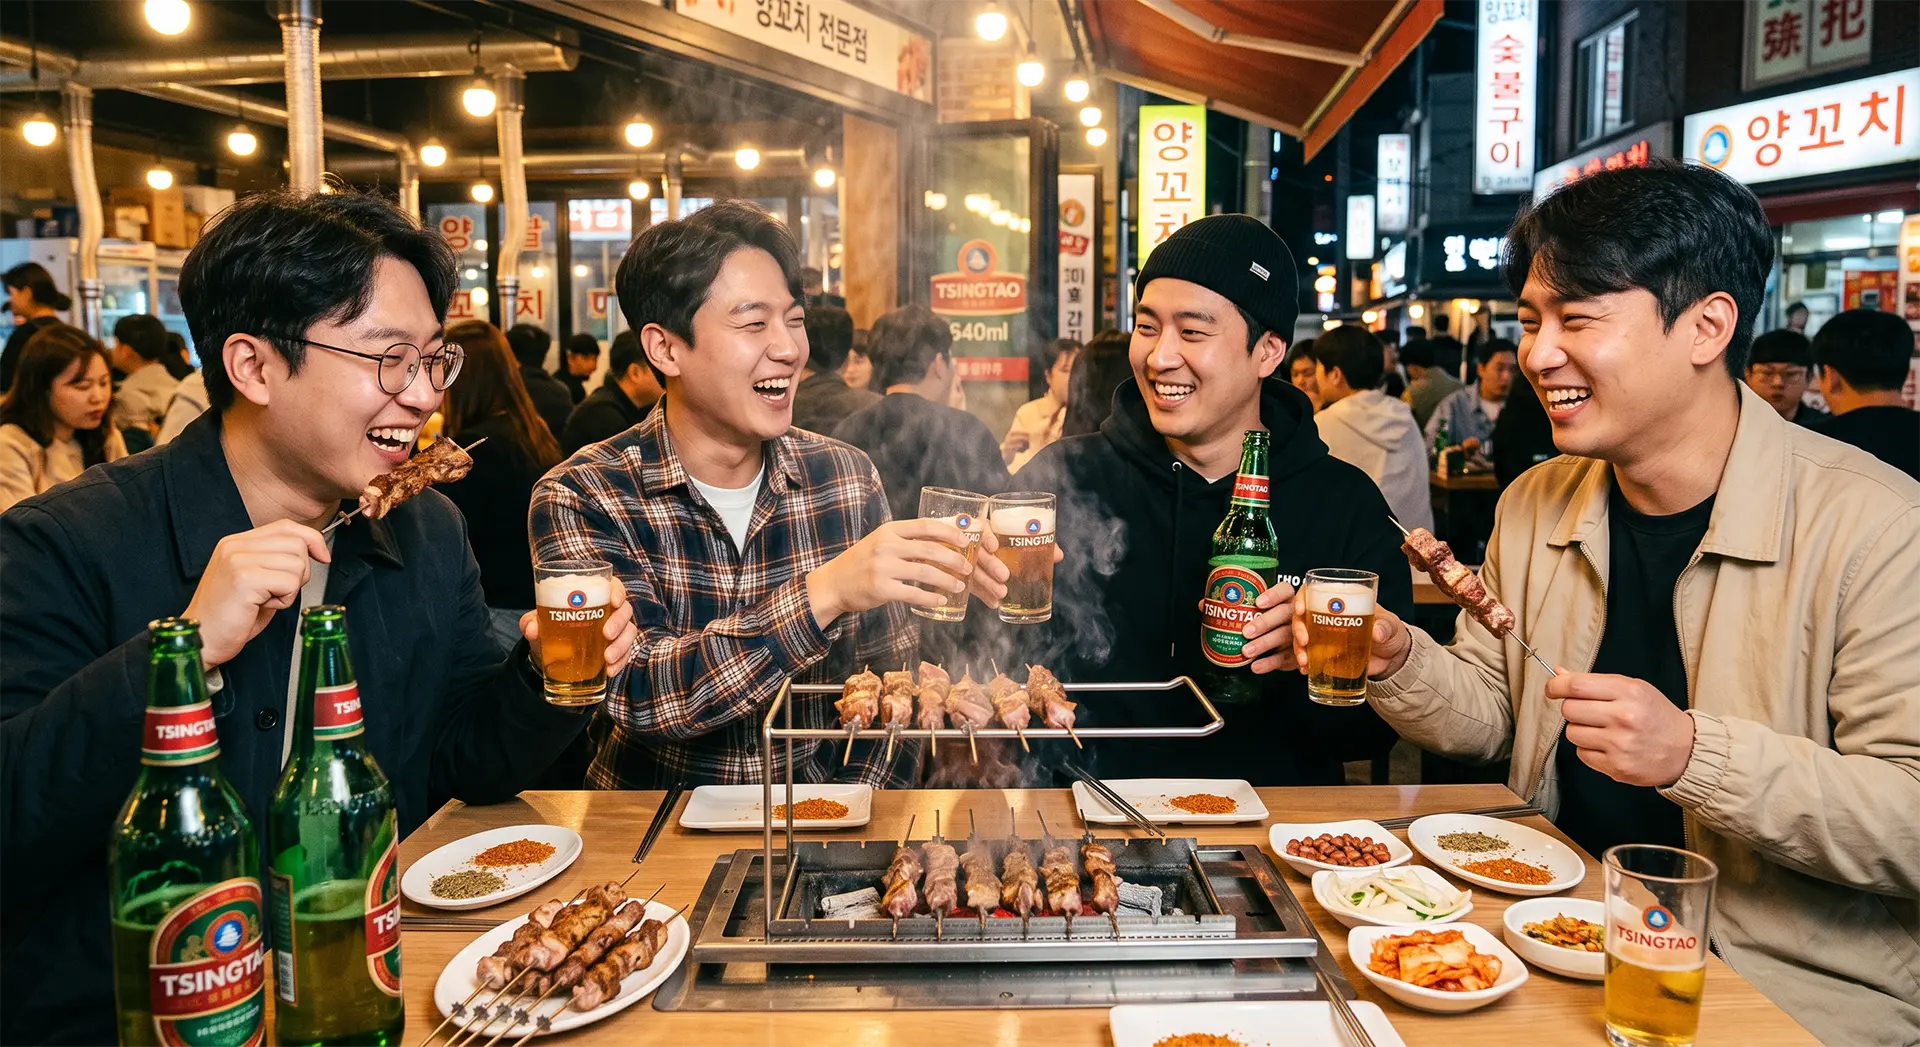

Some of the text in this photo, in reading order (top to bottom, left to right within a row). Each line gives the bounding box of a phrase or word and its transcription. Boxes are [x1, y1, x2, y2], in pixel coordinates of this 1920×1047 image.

[756, 0, 868, 64] 양꼬치 전문점
[1747, 85, 1905, 167] 양꼬치
[1153, 122, 1193, 243] 양꼬치
[935, 282, 1021, 299] TSINGTAO
[516, 289, 543, 320] 치
[1009, 534, 1055, 548] TSINGTAO
[549, 608, 605, 622] TSINGTAO
[1312, 614, 1364, 628] TSINGTAO
[1617, 925, 1697, 950] TSINGTAO
